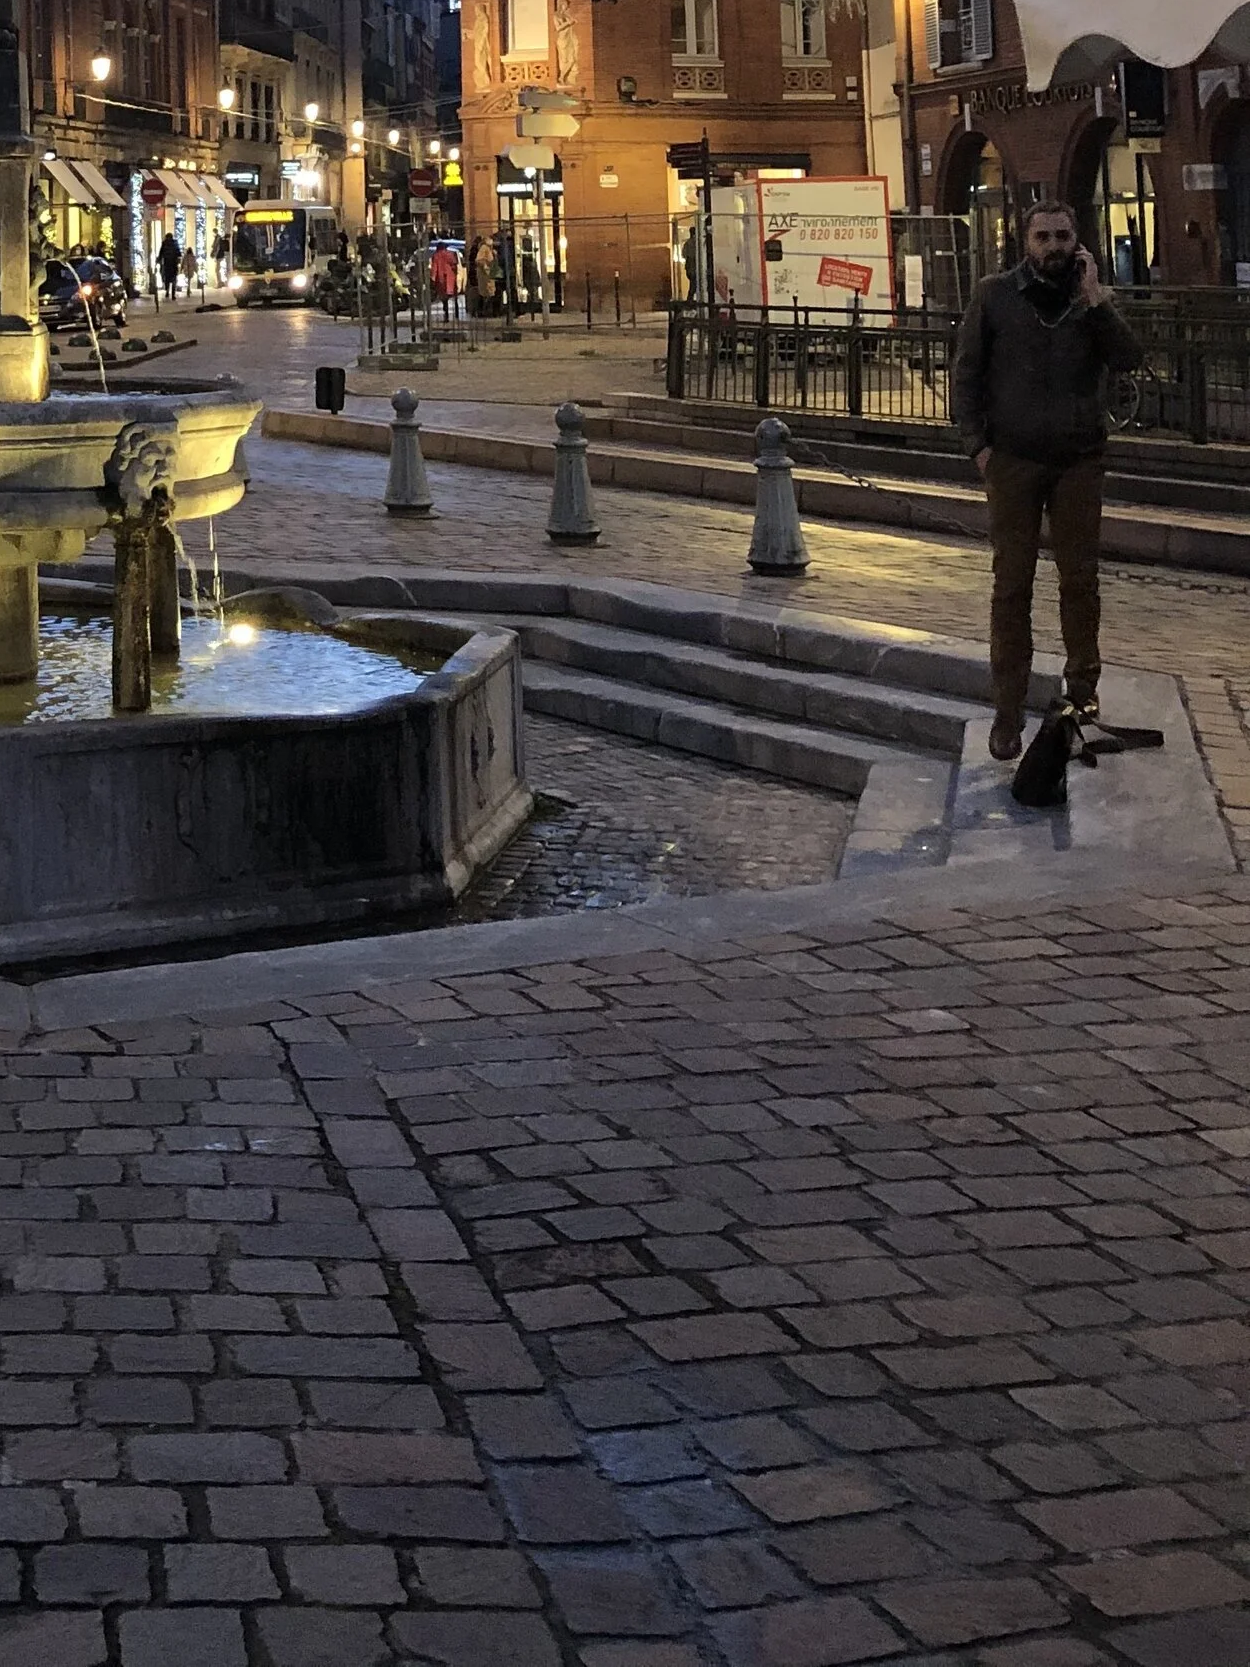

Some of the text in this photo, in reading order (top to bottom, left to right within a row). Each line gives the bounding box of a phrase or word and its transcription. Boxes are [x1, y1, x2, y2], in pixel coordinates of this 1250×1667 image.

[969, 84, 1022, 115] BANQUE
[768, 212, 799, 228] AXE
[800, 228, 878, 240] 0 820 820 150
